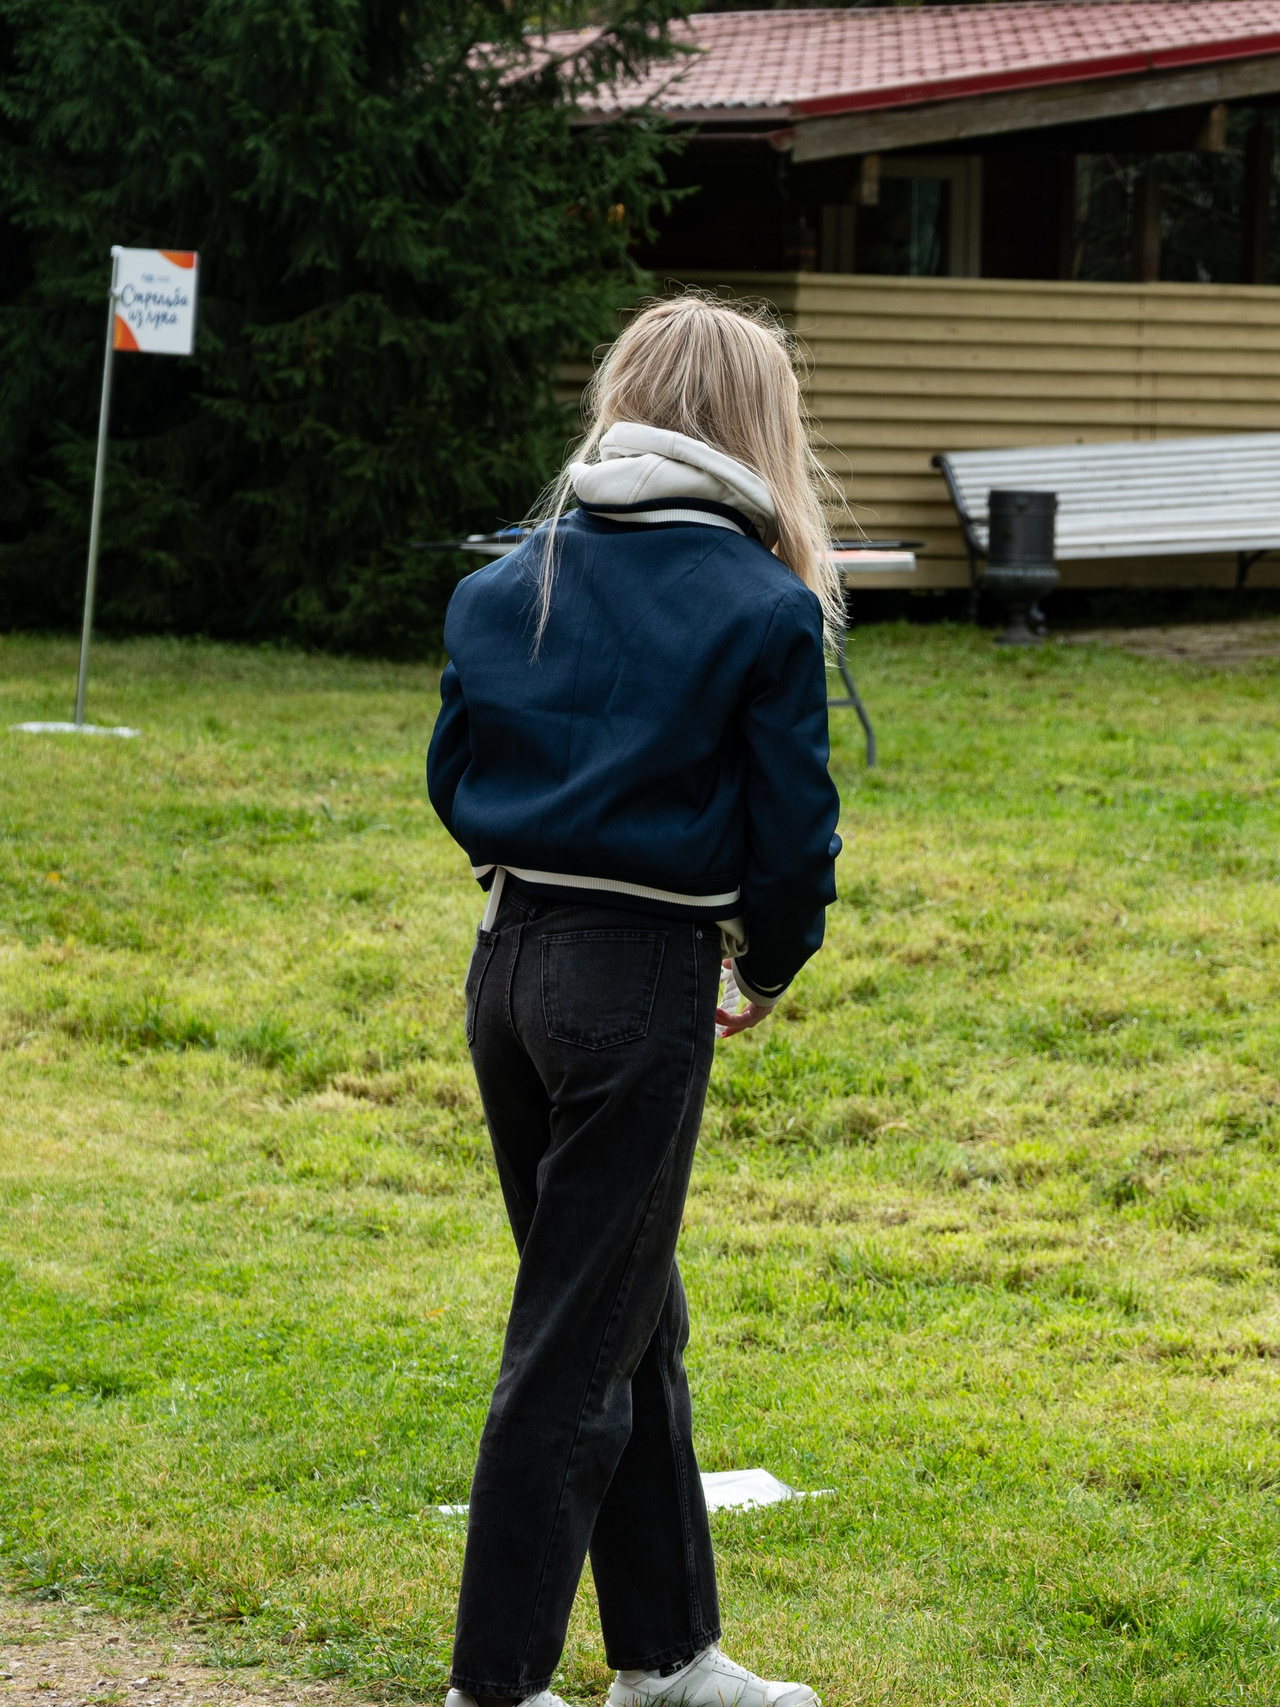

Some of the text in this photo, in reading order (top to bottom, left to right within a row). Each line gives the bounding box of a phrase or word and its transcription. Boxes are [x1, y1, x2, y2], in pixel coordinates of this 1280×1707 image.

[121, 283, 188, 309] Стрельба
[129, 310, 177, 329] из лука
